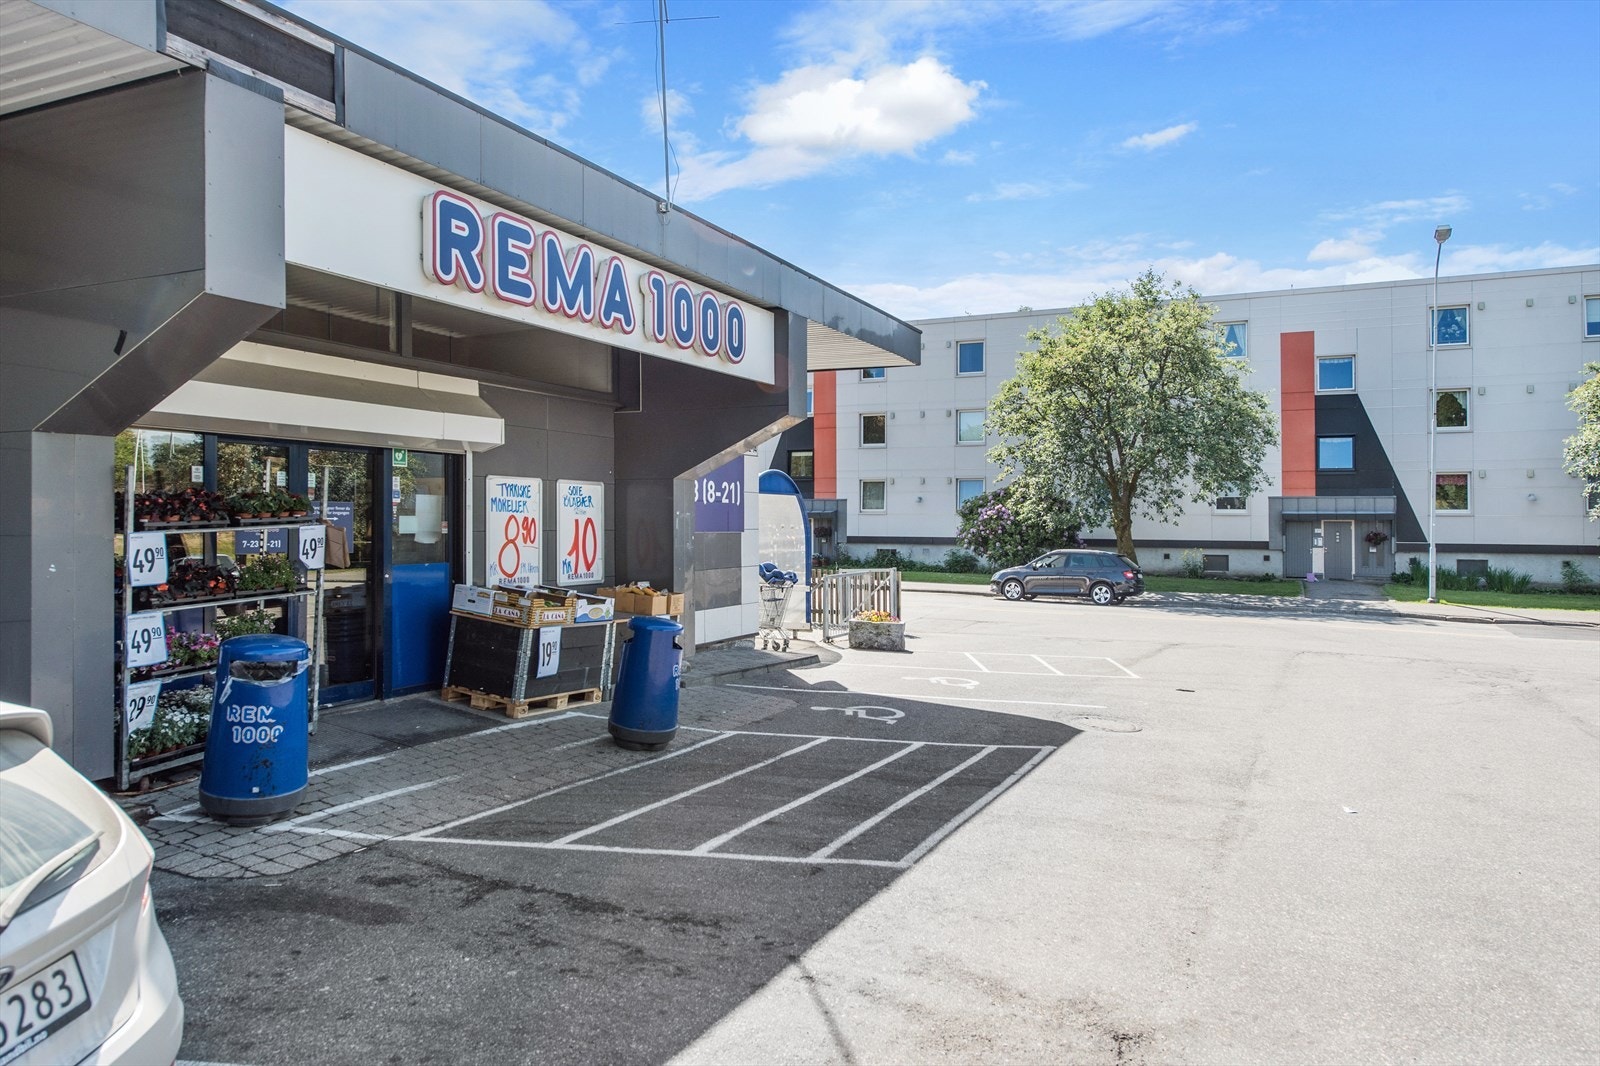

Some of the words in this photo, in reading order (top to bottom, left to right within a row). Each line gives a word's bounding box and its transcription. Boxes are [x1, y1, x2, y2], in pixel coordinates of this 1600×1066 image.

[432, 190, 636, 335] REMA
[647, 270, 747, 364] 1000
[703, 478, 741, 506] (8-21)
[242, 540, 260, 549] 7-23
[567, 517, 597, 574] 10
